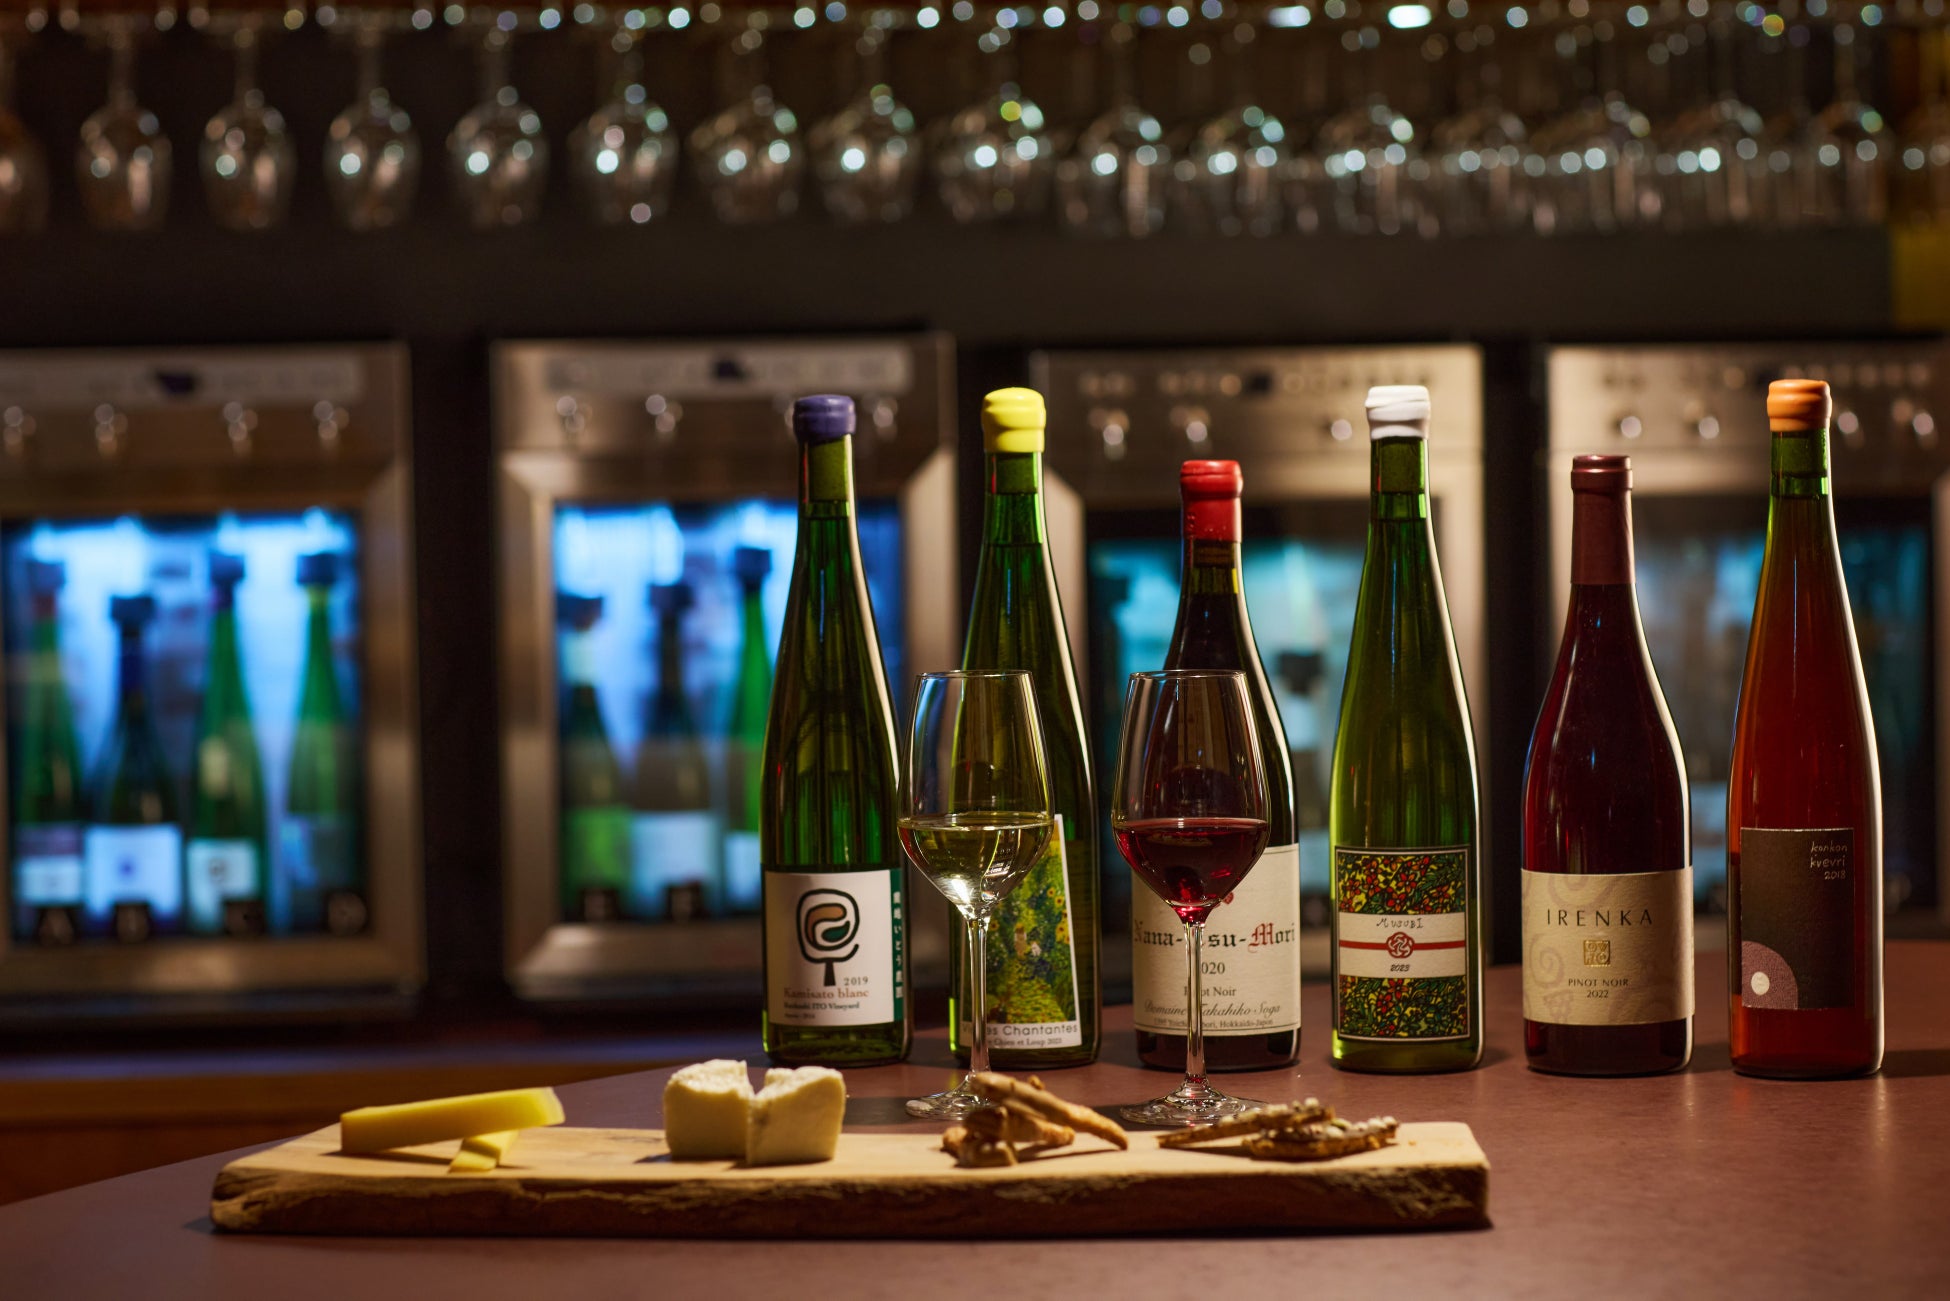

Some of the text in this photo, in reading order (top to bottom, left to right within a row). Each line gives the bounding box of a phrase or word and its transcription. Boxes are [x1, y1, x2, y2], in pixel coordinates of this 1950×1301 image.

[1824, 870, 1846, 880] 2018
[1547, 909, 1653, 927] IRENKA
[1200, 962, 1226, 975] 020
[1390, 964, 1411, 972] 2023
[843, 975, 869, 986] 2019
[1568, 978, 1629, 987] PINOT NOIR
[838, 987, 870, 999] blanc
[1184, 986, 1237, 997] Pot Noir
[1586, 990, 1609, 998] 2022
[1002, 1023, 1079, 1036] Chantantes
